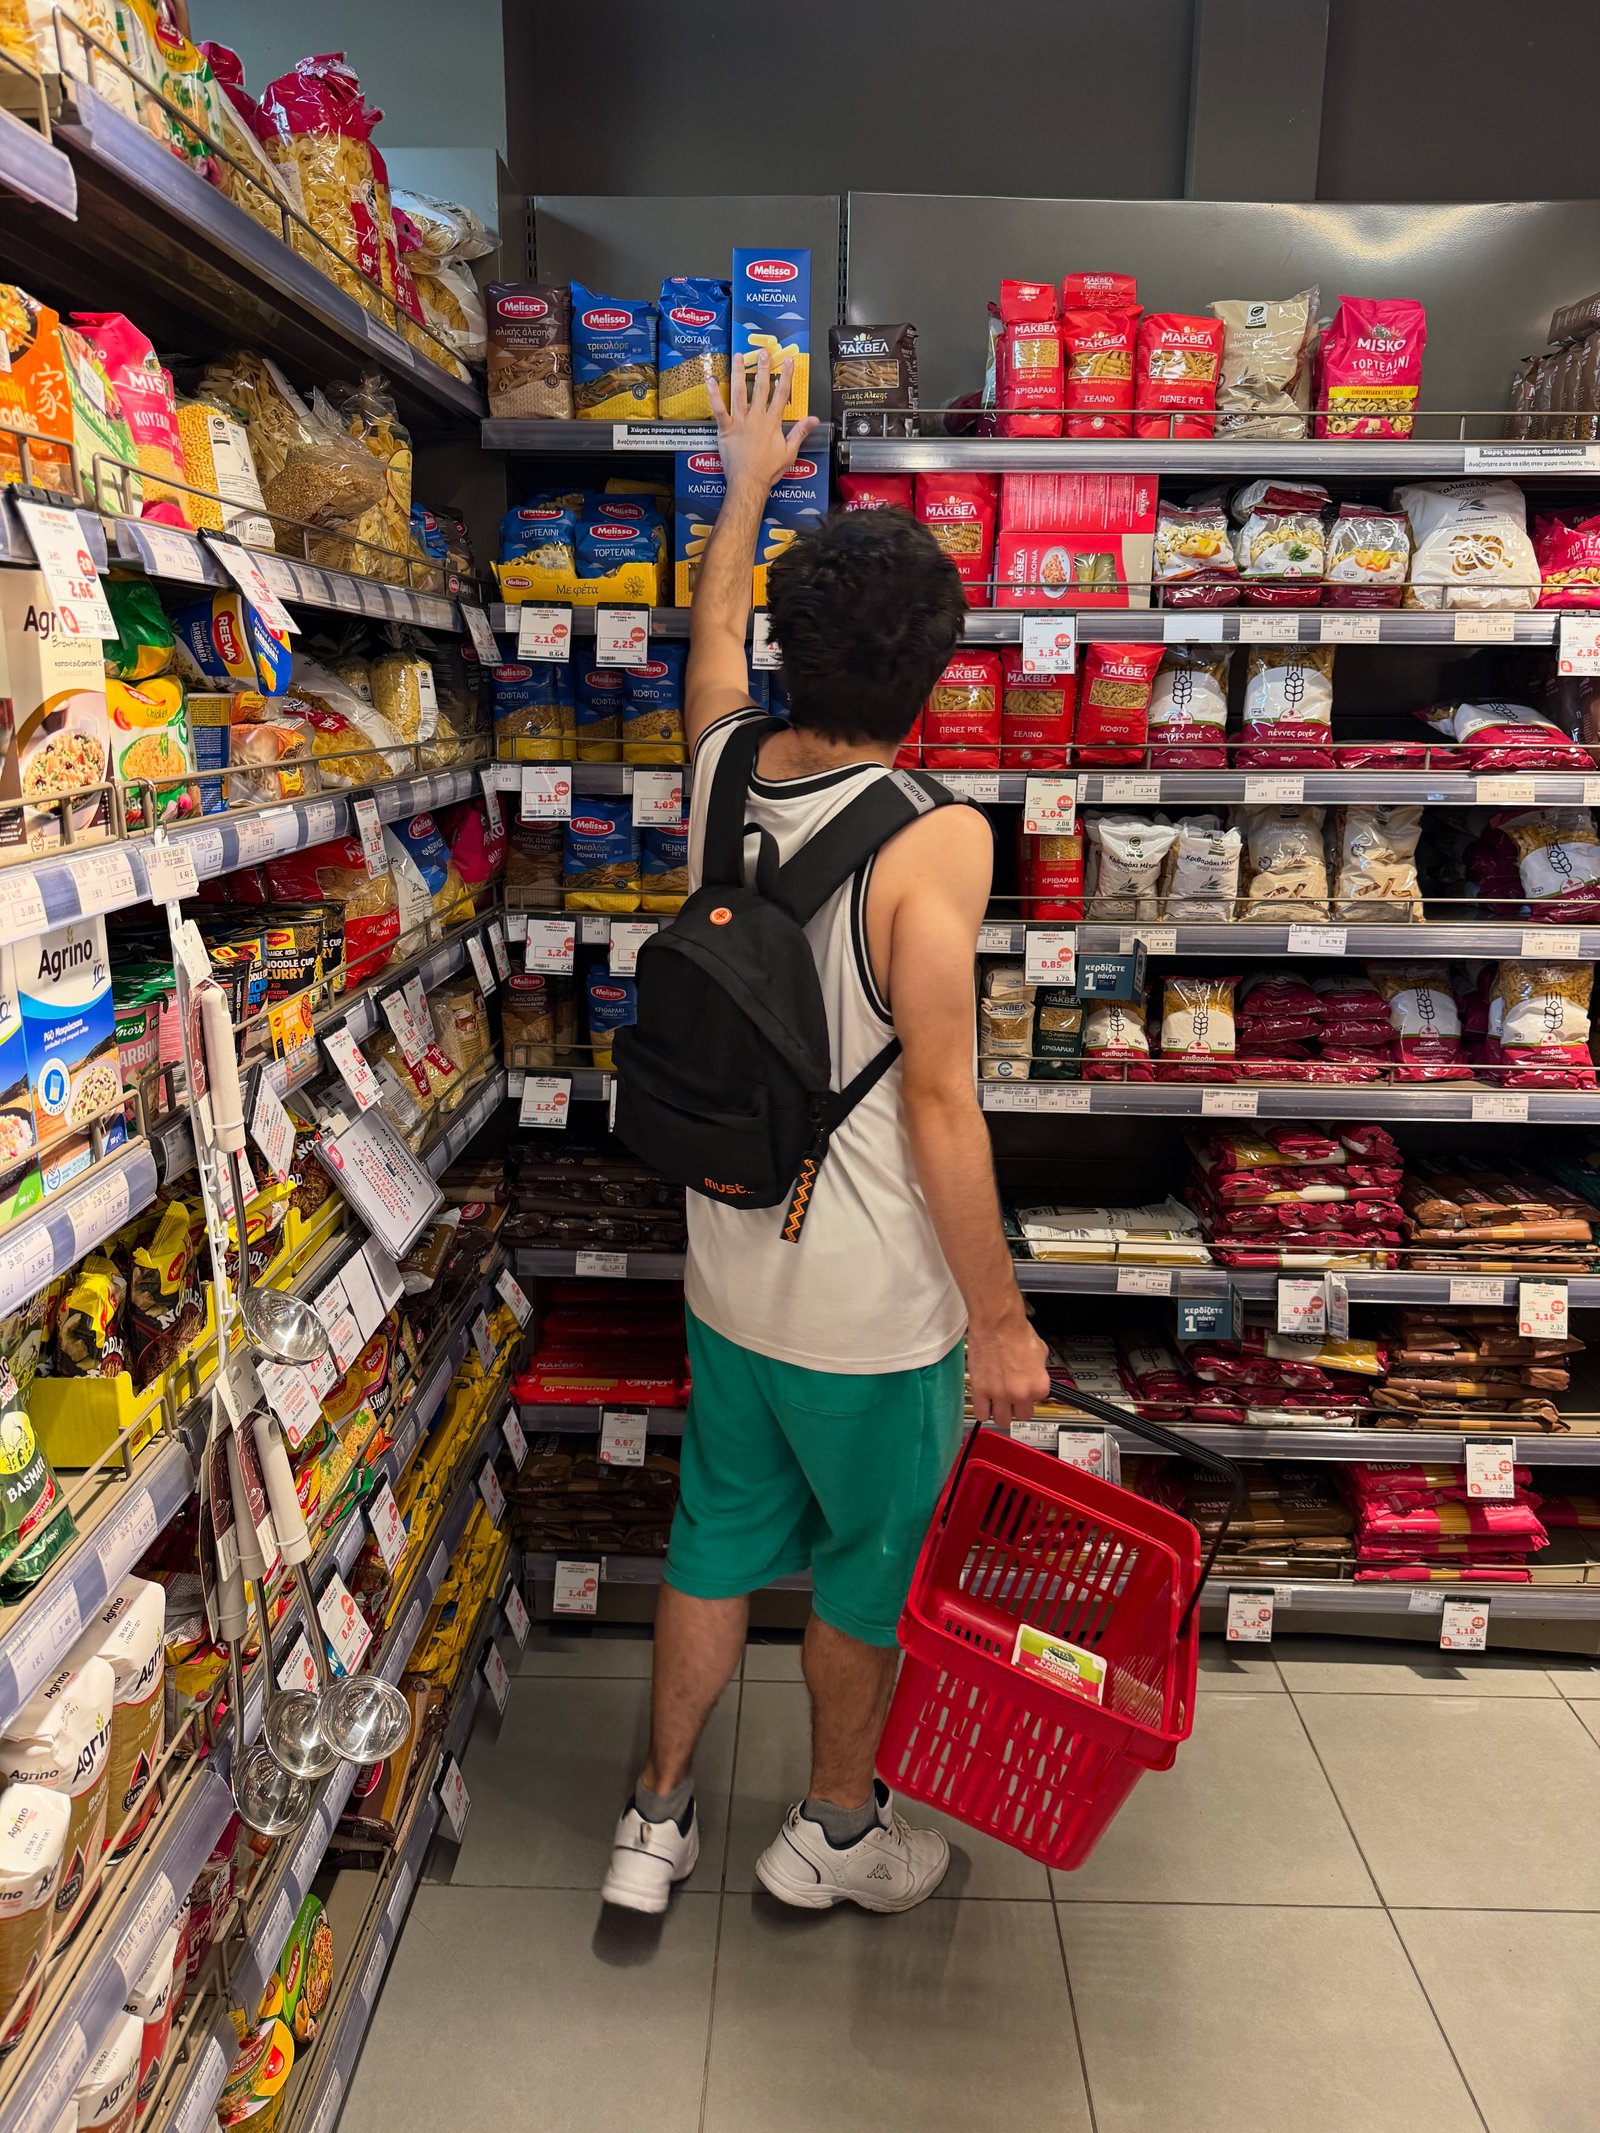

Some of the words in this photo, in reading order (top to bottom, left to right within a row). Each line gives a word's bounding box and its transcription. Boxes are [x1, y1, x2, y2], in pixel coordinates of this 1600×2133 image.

[754, 265, 791, 277] Melissa
[746, 293, 797, 304] ΚΑΝΕΛΟΝΙΑ
[504, 301, 540, 313] Melissa
[590, 314, 626, 324] Melissa
[676, 309, 711, 322] Melissa
[496, 328, 521, 337] ολικής
[523, 327, 552, 338] άλεσης
[1014, 324, 1057, 335] ΜΑΚΒΕΛ
[675, 335, 711, 344] ΚΟΦΤΑΚΙ
[1074, 336, 1127, 348] ΜΑΚΒΕΛ
[1160, 332, 1212, 346] ΜΑΚΒΕΛ
[587, 341, 629, 351] τρικολόρε
[838, 342, 889, 355] ΜΑΚΒΕΛ
[1357, 338, 1406, 352] MISKO
[591, 351, 613, 359] ΠΕΝΝΕΣ
[1352, 356, 1410, 371] ΤΟΡΤΕΛΙΝΙ
[1377, 369, 1398, 378] ΤΥΡΙΑ
[30, 362, 69, 420] 家
[1015, 386, 1056, 394] ΚΡΙΘΑΡΑΚΙ
[1084, 395, 1115, 403] ΣΕΛΙΝΟ
[1159, 395, 1178, 404] ΠΕΝΕΣ
[1180, 396, 1204, 405] ΡΙΓΕ
[651, 427, 686, 435] προσωρινής
[926, 506, 977, 517] ΜΑΚΒΕΛ
[520, 528, 559, 539] ΤΟΡΤΕΛΙΝΙ
[597, 526, 632, 536] Melissa
[594, 547, 636, 557] ΤΟΡΤΕΛΙΝΙ
[556, 584, 572, 594] Με
[573, 583, 600, 597] φέτα
[191, 622, 207, 663] CARBONARA
[200, 620, 208, 648] Instant
[204, 648, 214, 663] Pasta
[217, 615, 239, 661] REEVA
[1101, 663, 1147, 677] ΜΑΚΒΕΛ
[1007, 673, 1056, 683] ΜΑΚΒΕΛ
[633, 689, 659, 699] ΚΟΦΤΟ
[146, 707, 168, 718] Chicken
[1100, 725, 1129, 733] ΚΟΦΤΟ
[1267, 728, 1295, 738] πέννες
[1297, 728, 1315, 739] ριγέ
[576, 821, 608, 830] Melissa
[573, 844, 611, 852] τρικολόρε
[1186, 854, 1220, 866] Κριθαράκι
[37, 938, 93, 982] Agrino
[301, 957, 314, 966] CUP
[1085, 963, 1125, 973] κερδίζετε
[268, 968, 305, 980] CURRY
[1084, 972, 1096, 990] 1
[1045, 995, 1082, 1005] ΜΑΚΒΕΛ
[1041, 1045, 1074, 1053] ΚΡΙΘΑΡΑΚΙ
[379, 1127, 424, 1186] ΑΓΟΡΑΖΟΝΤΑΣ
[369, 1135, 416, 1197] ΣΥΜΜΕΤΕΧΕΤΕ
[385, 1149, 408, 1177] MAGGI
[1184, 1307, 1223, 1315] κερδίζετε
[1185, 1315, 1197, 1332] 1
[1367, 1463, 1411, 1471] MISKO
[7, 1457, 46, 1503] BASMATI
[103, 1597, 124, 1623] Agrino
[44, 1671, 71, 1699] Agrino
[9, 1768, 59, 1782] Agrino
[8, 1807, 29, 1839] Agrino
[285, 1950, 301, 1994] REEVA
[231, 2043, 265, 2072] REEVA
